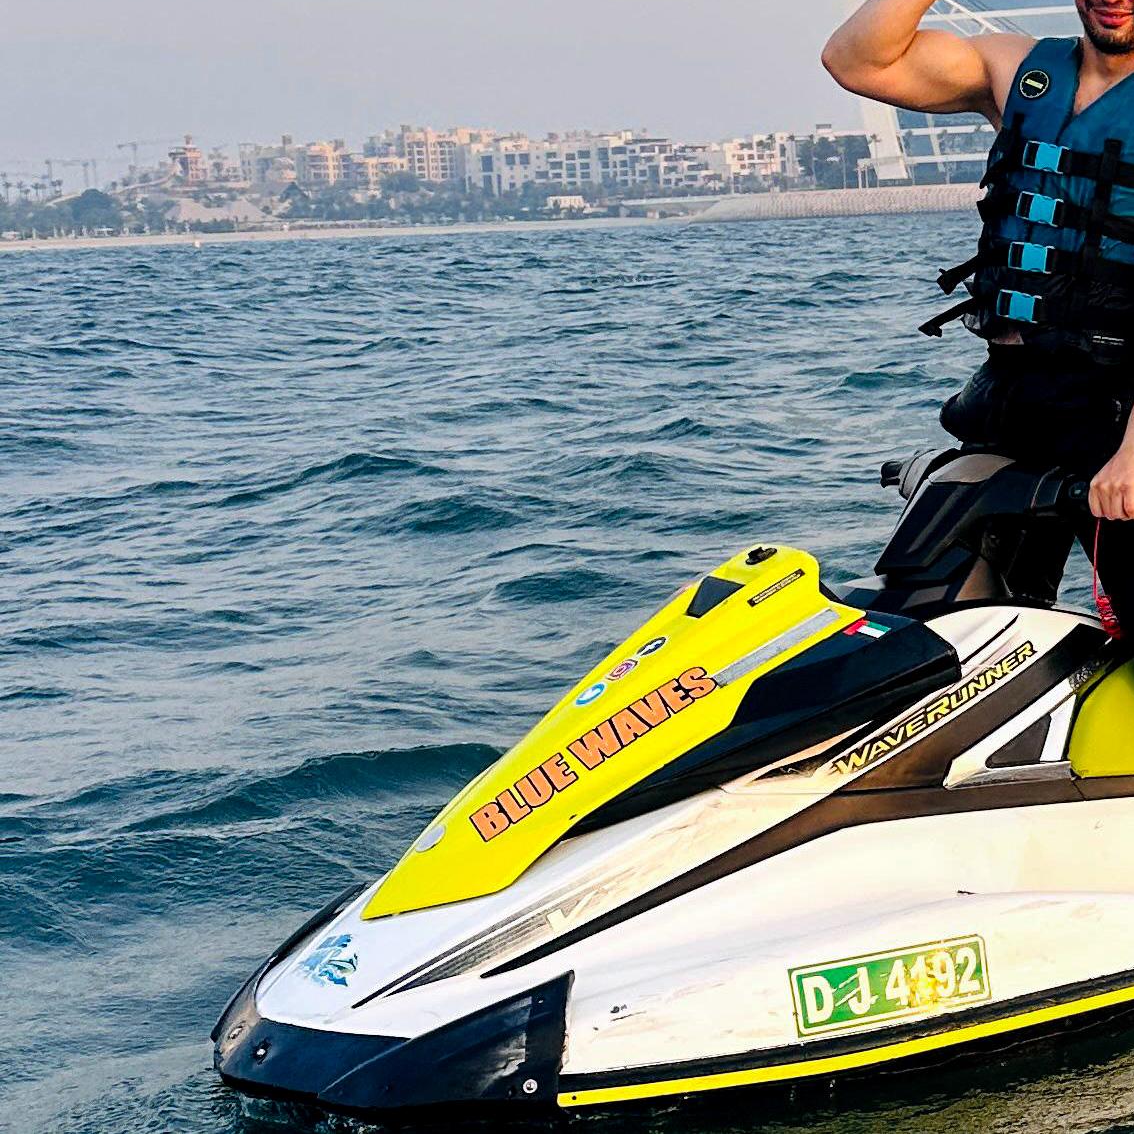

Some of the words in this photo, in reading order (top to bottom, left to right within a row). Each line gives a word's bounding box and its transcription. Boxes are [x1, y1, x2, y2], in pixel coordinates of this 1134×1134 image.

[469, 752, 578, 842] BLUE
[566, 666, 718, 771] WAVES
[831, 640, 1038, 775] WAVERUNNER
